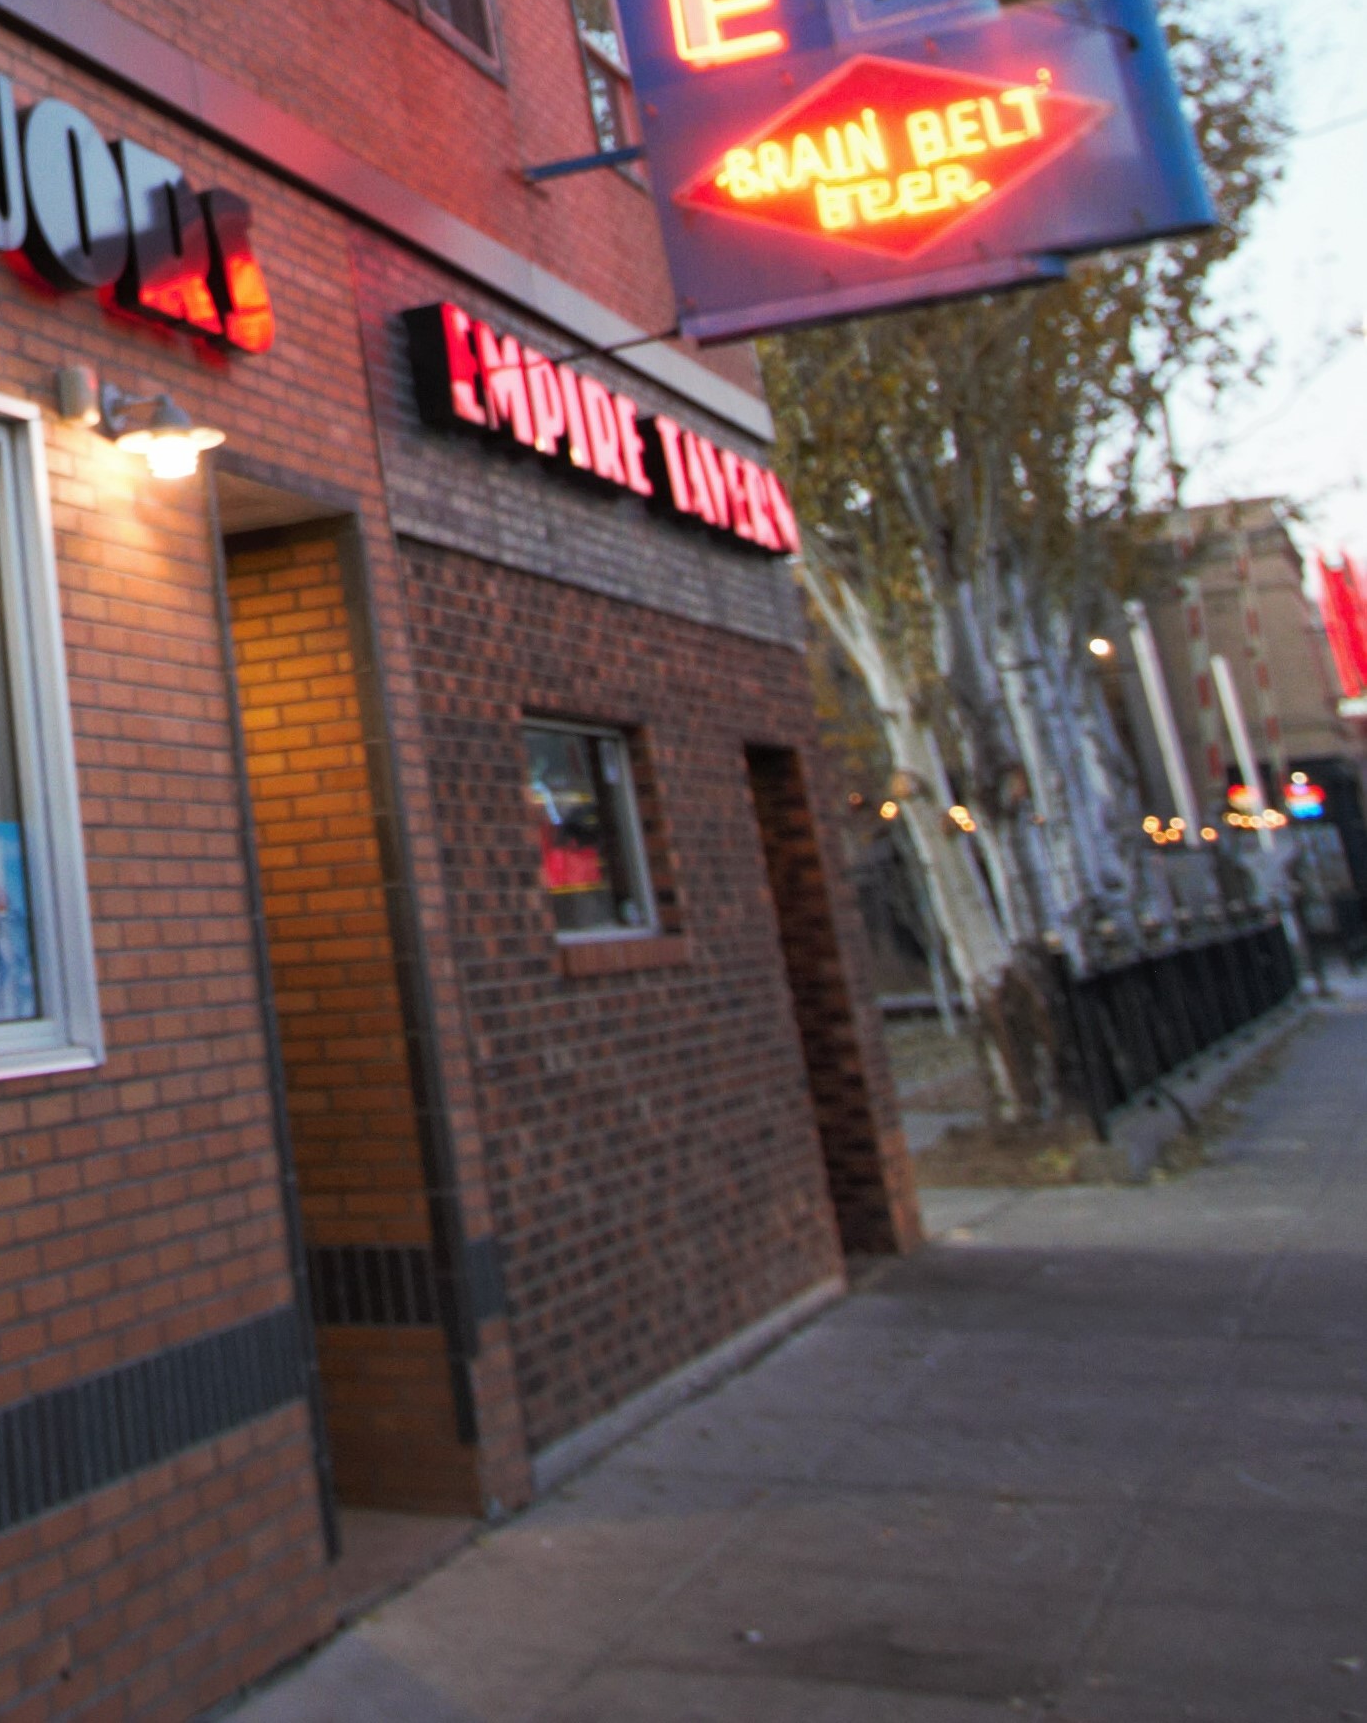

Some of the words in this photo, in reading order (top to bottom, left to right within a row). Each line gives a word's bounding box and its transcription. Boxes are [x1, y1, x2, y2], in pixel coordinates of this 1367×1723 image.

[905, 84, 1043, 167] BELT
[815, 163, 992, 232] BEER
[439, 301, 654, 497] EMPIRE
[655, 413, 801, 555] TAVERN
